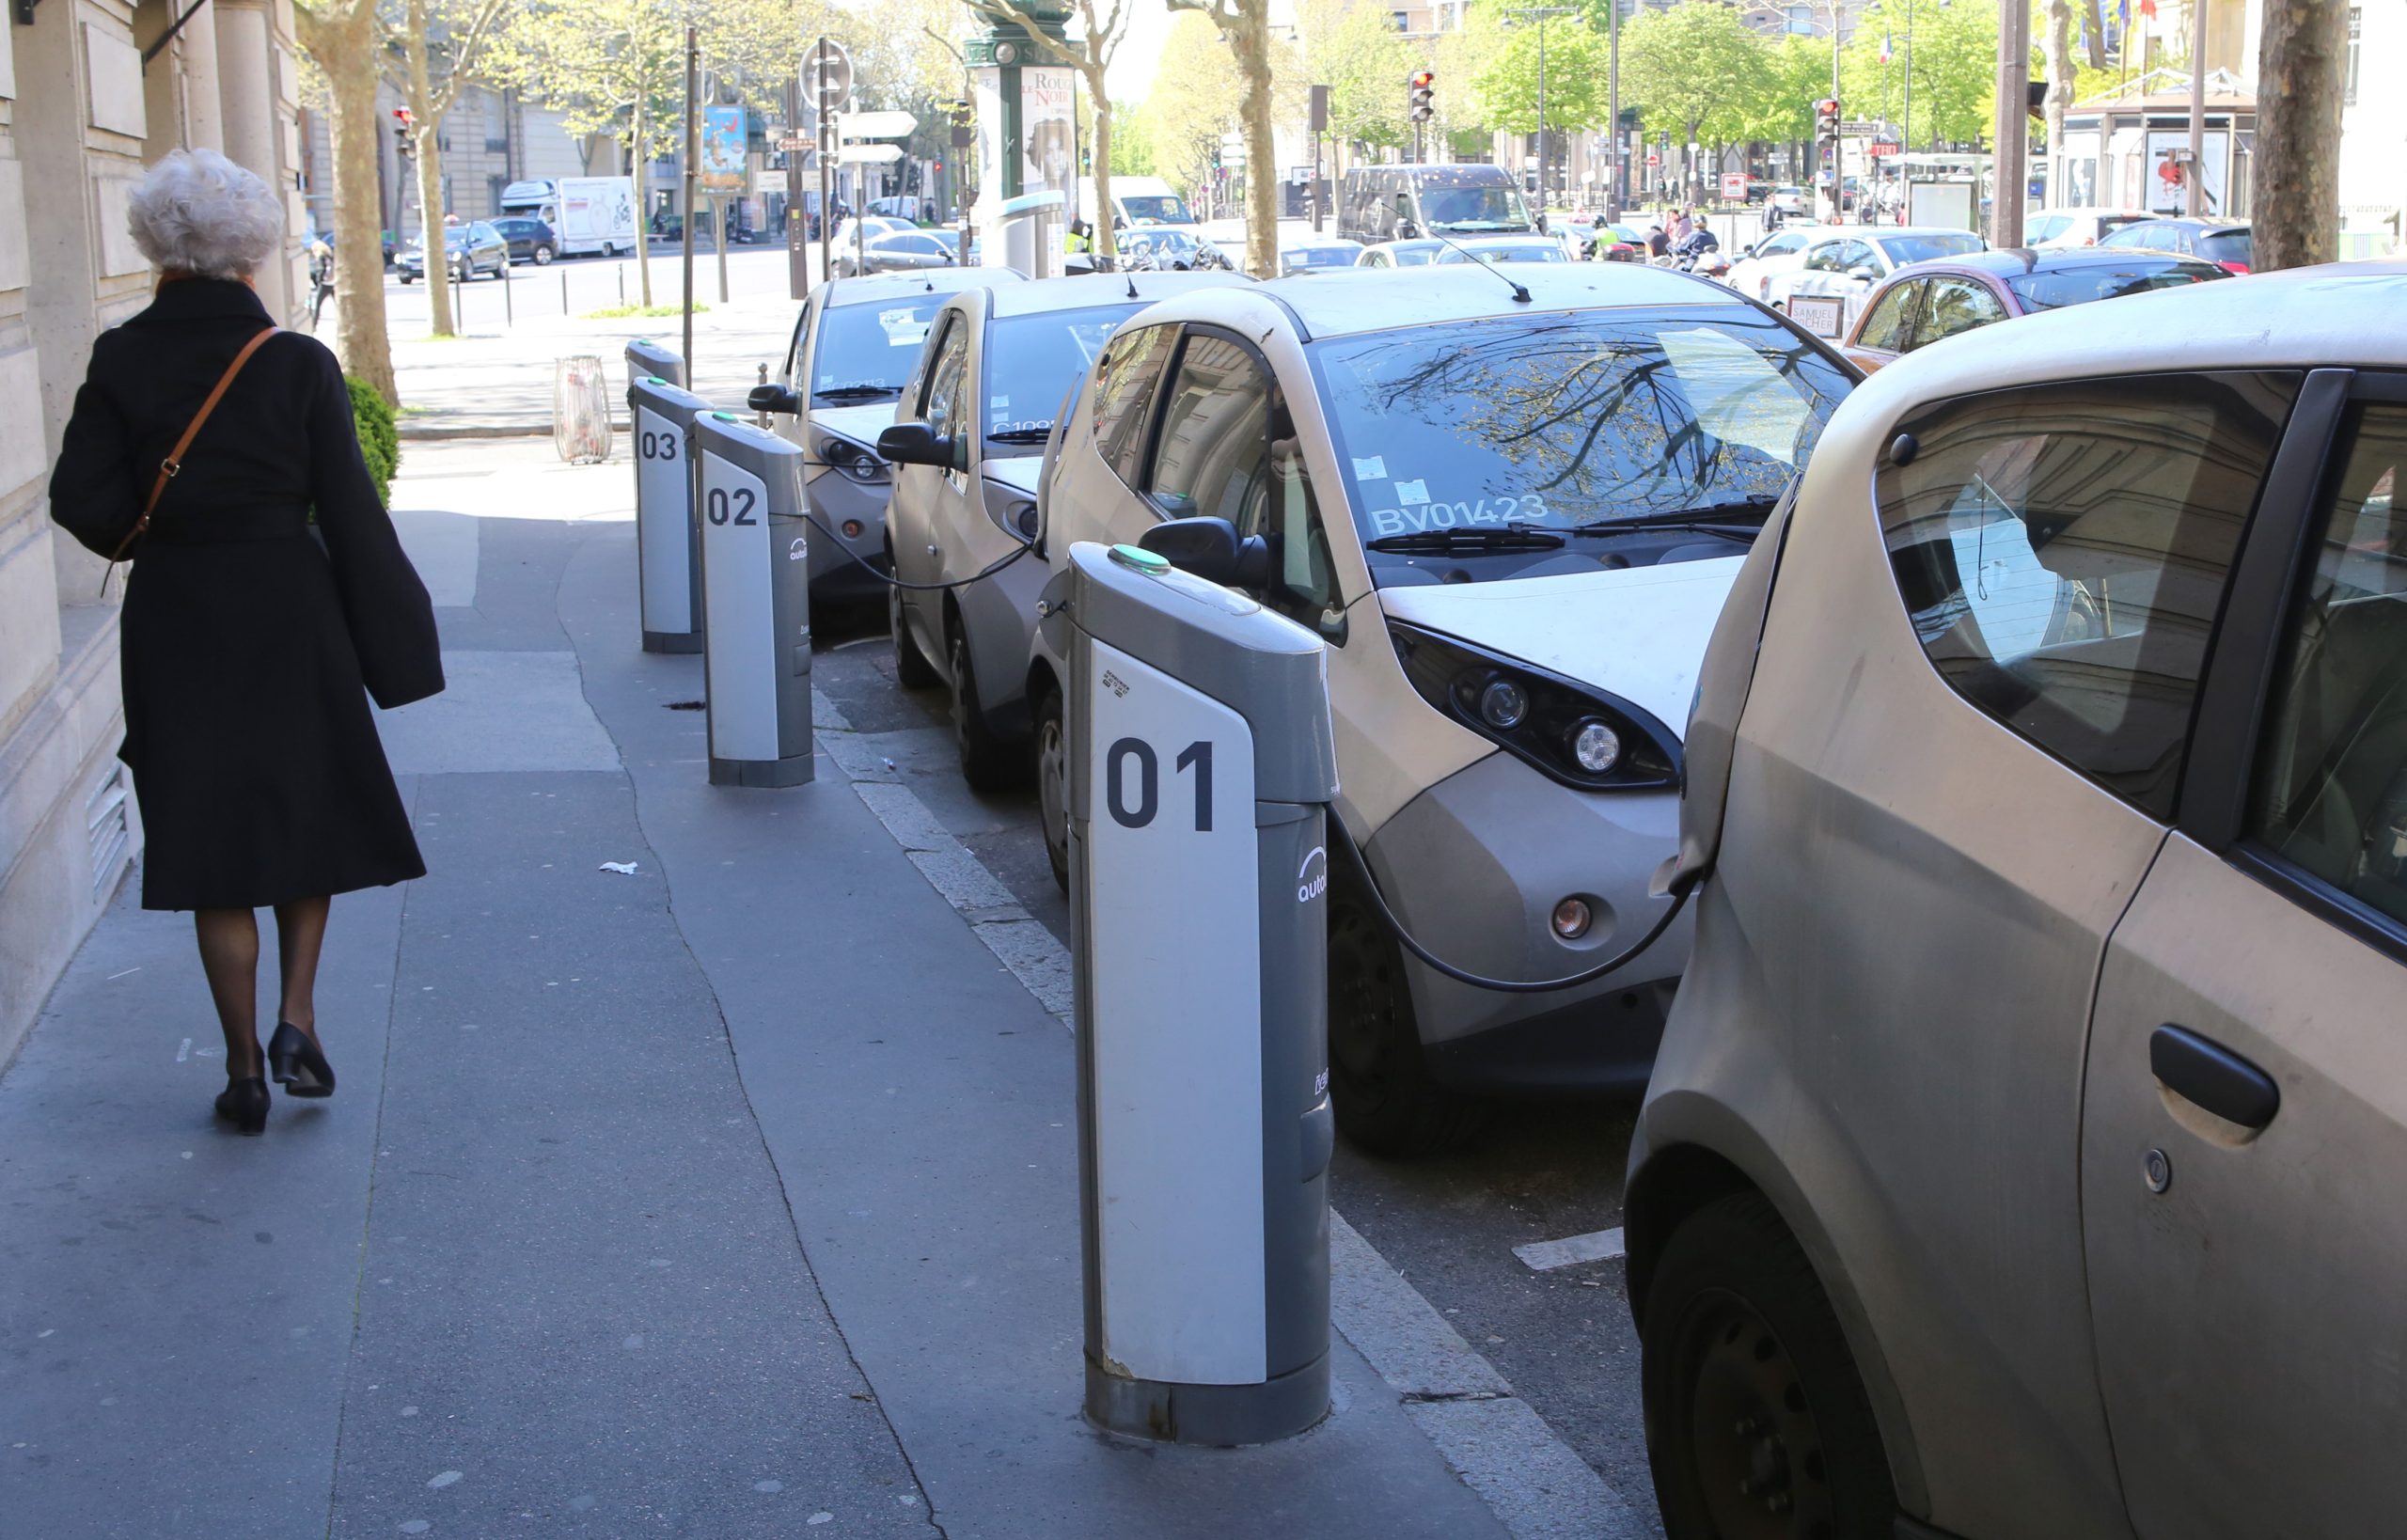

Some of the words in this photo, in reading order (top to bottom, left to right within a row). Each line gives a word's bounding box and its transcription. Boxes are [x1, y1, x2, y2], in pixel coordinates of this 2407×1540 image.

[1035, 90, 1068, 106] NOIR
[1793, 307, 1833, 320] SAMUEL
[642, 432, 676, 461] 03
[708, 488, 757, 526] 02
[1371, 495, 1550, 536] BV01423
[1107, 737, 1213, 832] 01
